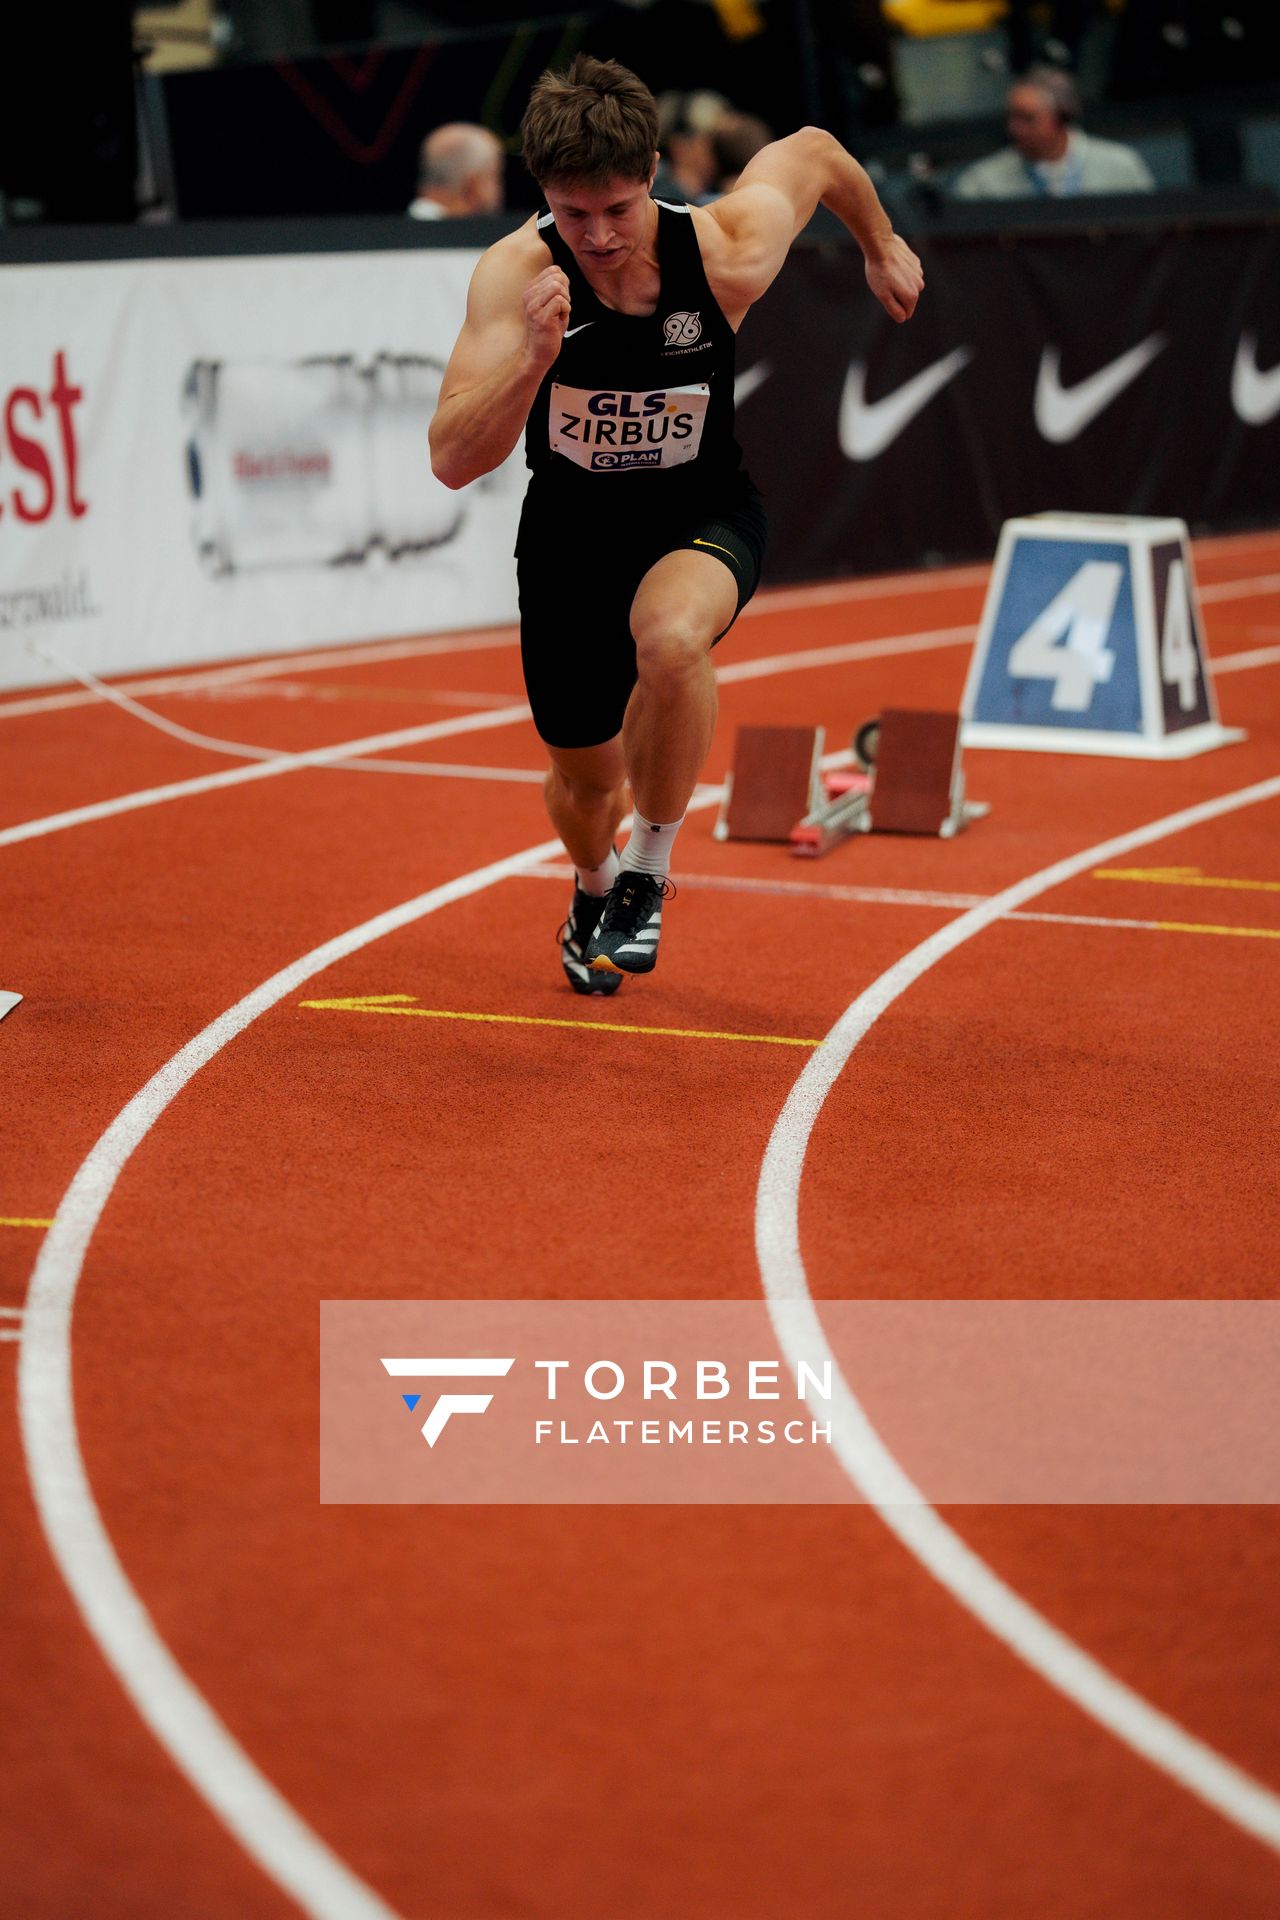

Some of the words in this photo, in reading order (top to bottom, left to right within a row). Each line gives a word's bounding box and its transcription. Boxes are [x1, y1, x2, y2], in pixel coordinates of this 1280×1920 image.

[664, 312, 701, 346] 96
[0, 349, 88, 524] st
[560, 412, 694, 446] ZIRBUS
[621, 452, 659, 462] PLAN
[1008, 559, 1123, 713] 4
[1161, 558, 1197, 712] 4
